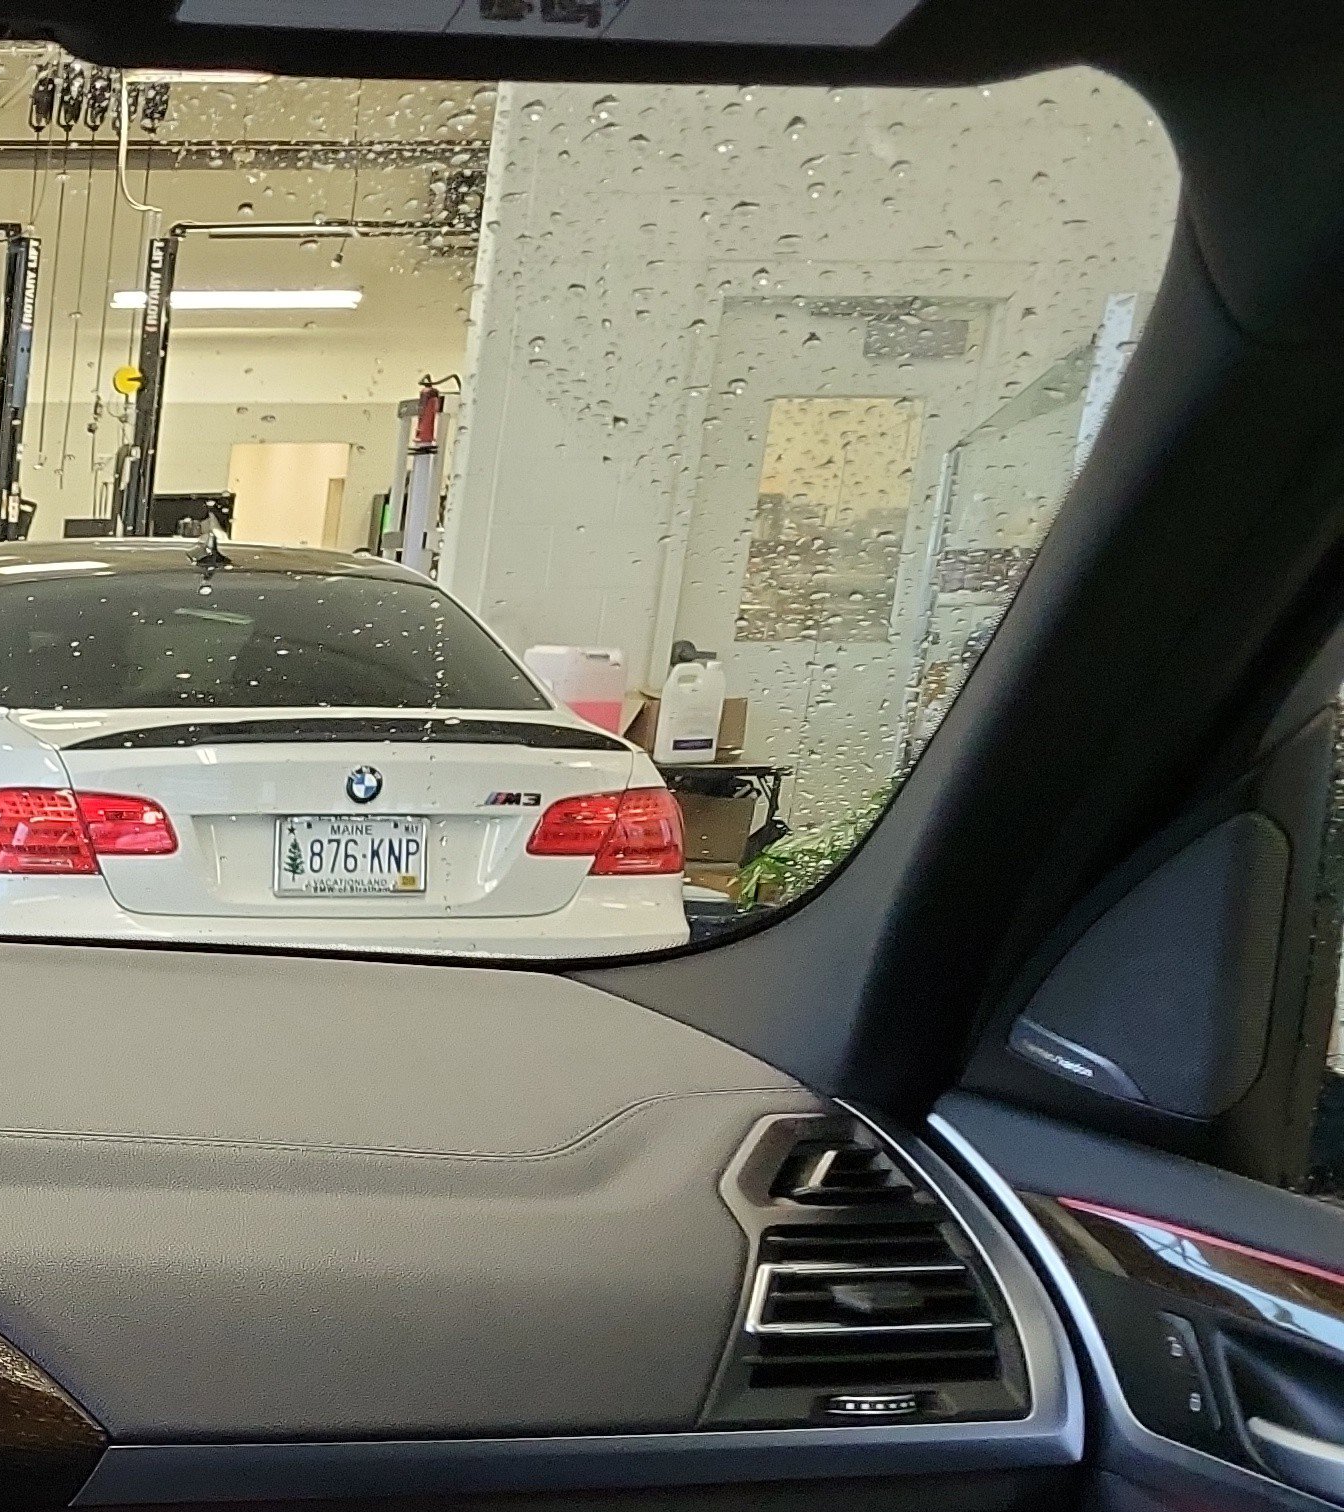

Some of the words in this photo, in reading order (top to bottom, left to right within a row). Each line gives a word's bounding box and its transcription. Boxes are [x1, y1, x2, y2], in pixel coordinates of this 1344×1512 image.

[27, 239, 41, 268] LIFT
[151, 239, 165, 268] LIFT
[22, 270, 37, 324] ROTARY
[146, 271, 162, 324] ROTARY
[494, 792, 541, 806] M3
[330, 825, 373, 836] MAINE
[312, 878, 387, 887] VACATIONLAND
